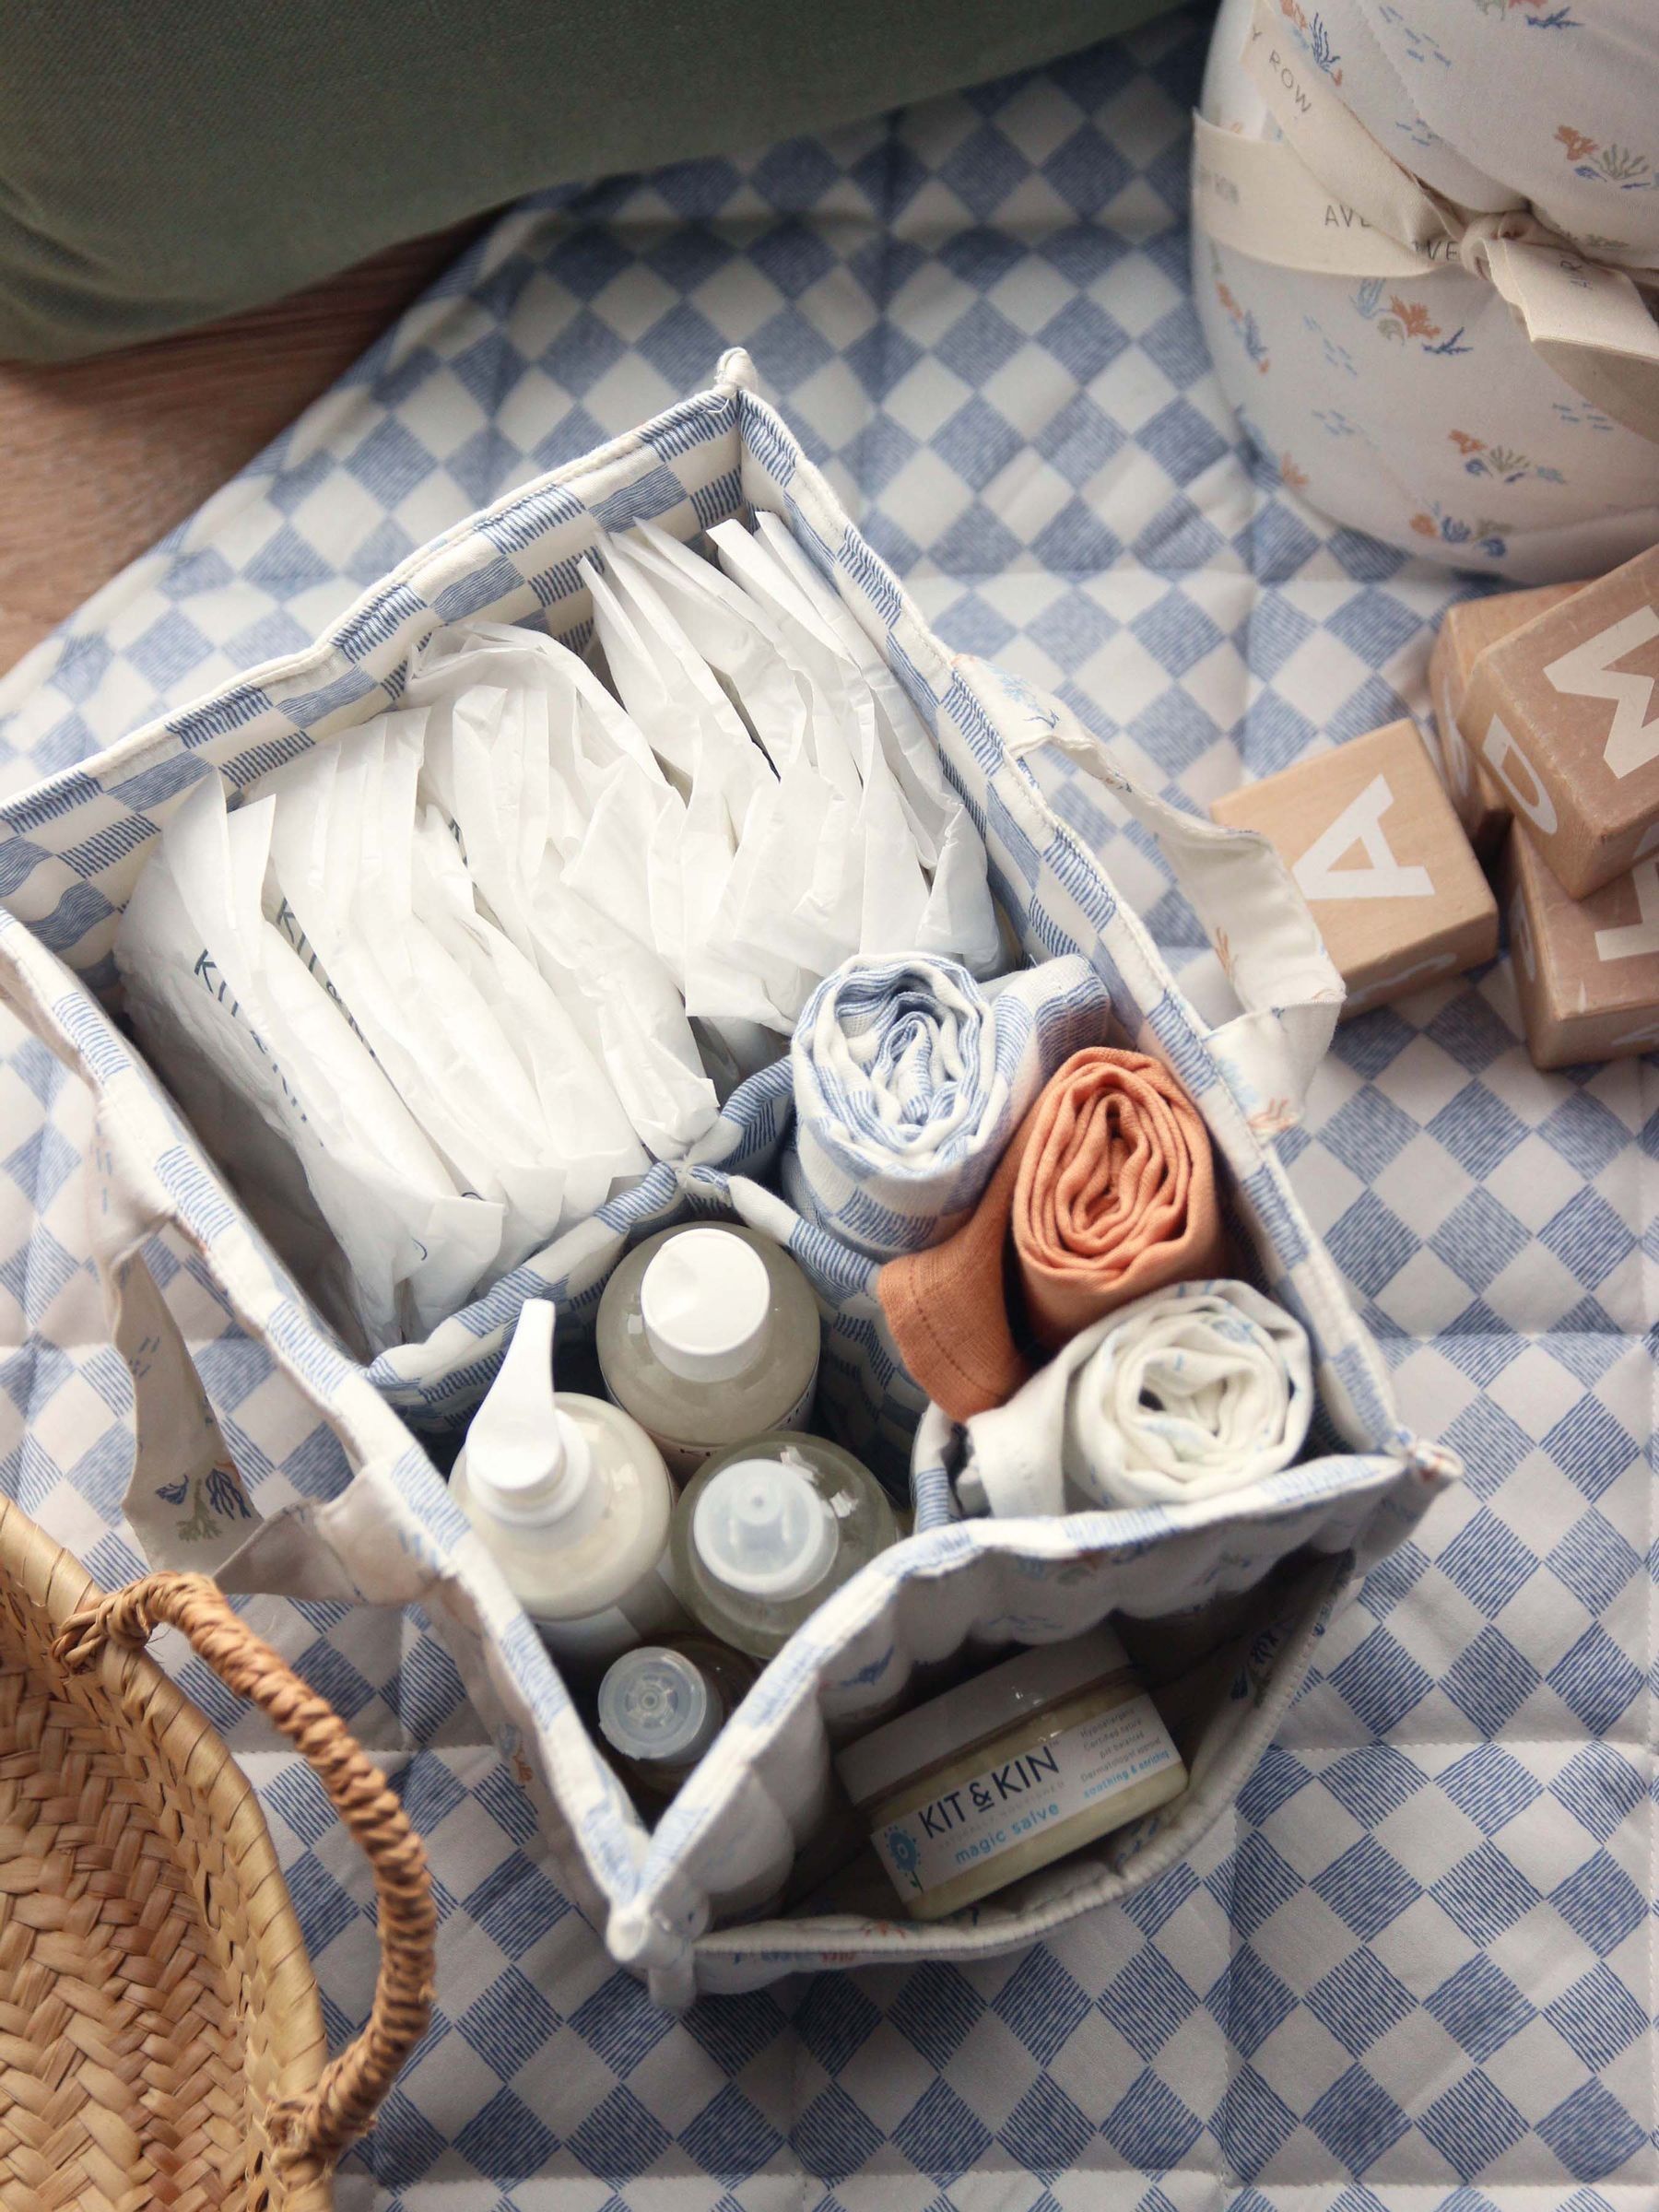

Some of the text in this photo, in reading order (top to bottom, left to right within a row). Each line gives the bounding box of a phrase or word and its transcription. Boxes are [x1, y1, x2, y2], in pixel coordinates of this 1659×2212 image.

[1269, 49, 1312, 112] ROW
[1291, 773, 1435, 900] A
[918, 1791, 966, 1840] KIT
[969, 1782, 995, 1813] &
[991, 1746, 1059, 1801] KIN
[1084, 1770, 1130, 1799] soothing
[955, 1830, 1007, 1865] magic
[1011, 1803, 1059, 1835] salve
